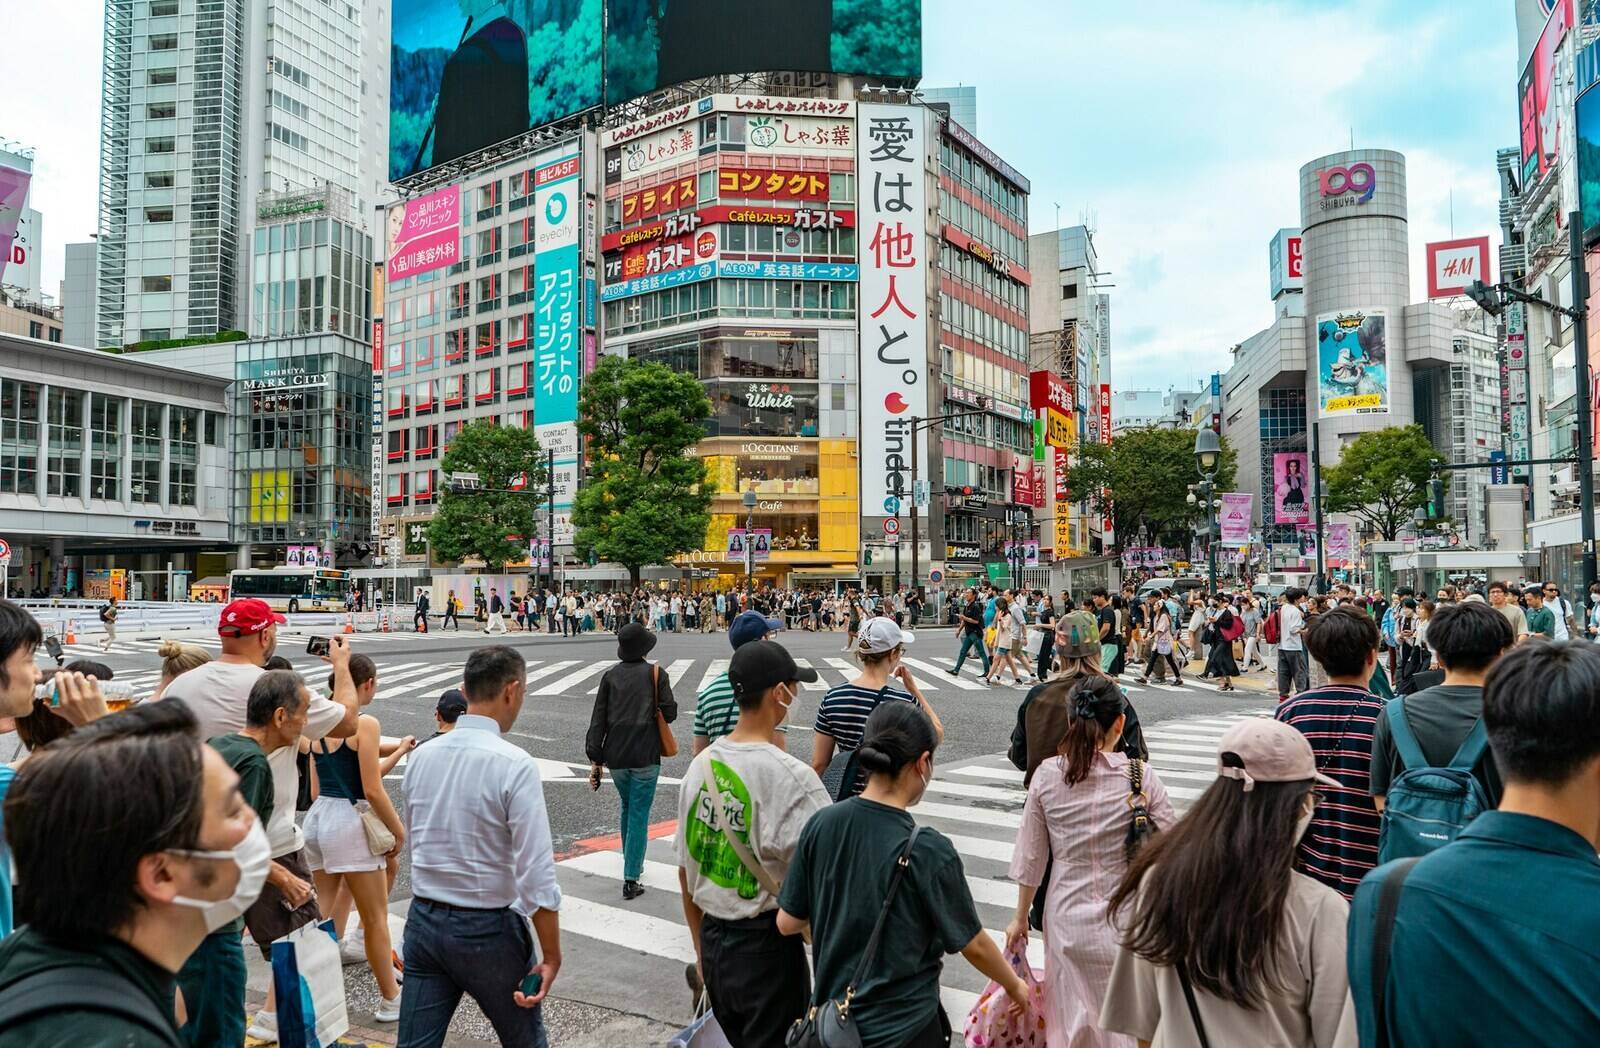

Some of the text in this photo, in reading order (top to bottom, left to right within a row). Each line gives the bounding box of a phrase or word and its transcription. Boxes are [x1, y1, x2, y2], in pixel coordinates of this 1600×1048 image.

[736, 97, 848, 114] しゃぶしゃぶバイキング
[612, 105, 691, 142] しゃぶしゃぶバイキング
[784, 123, 850, 146] しゃぶ葉
[648, 130, 693, 161] しゃぶ葉
[539, 160, 575, 183] 当ビル5F
[607, 158, 621, 173] 9F
[720, 171, 826, 195] コンタクト
[1315, 163, 1375, 205] 109
[419, 194, 457, 215] 品川スキン
[624, 178, 696, 217] プライス
[1320, 196, 1355, 209] SHIBUYA
[418, 209, 452, 230] クリニック
[665, 213, 701, 238] ガスト
[729, 209, 843, 229] Caféレストラン ガスト
[539, 223, 573, 243] eyecity
[397, 241, 456, 272] 品川美容外科
[646, 243, 691, 273] ガスト
[699, 242, 715, 252] ガスト
[869, 117, 917, 385] 愛は他人と。
[606, 260, 622, 278] 7F
[725, 263, 856, 277] AEON 英会話イーオン
[1443, 256, 1475, 278] H&M
[604, 269, 696, 296] AEON 英会話イーオン
[539, 274, 557, 395] アイシティ
[559, 269, 572, 393] コンタクトの
[243, 374, 329, 389] MARK CITY
[264, 367, 305, 377] SHIBUYA
[1048, 381, 1073, 413] スギ薬局
[1023, 410, 1033, 422] 4F
[543, 428, 568, 438] CONTACT
[1102, 412, 1110, 446] TaxFre
[741, 442, 800, 453] L'OCCITANE
[884, 417, 910, 500] tinder
[1014, 474, 1029, 489] アコム
[759, 500, 783, 512] Café
[1057, 504, 1068, 545] 処方せん
[702, 796, 745, 827] Spite
